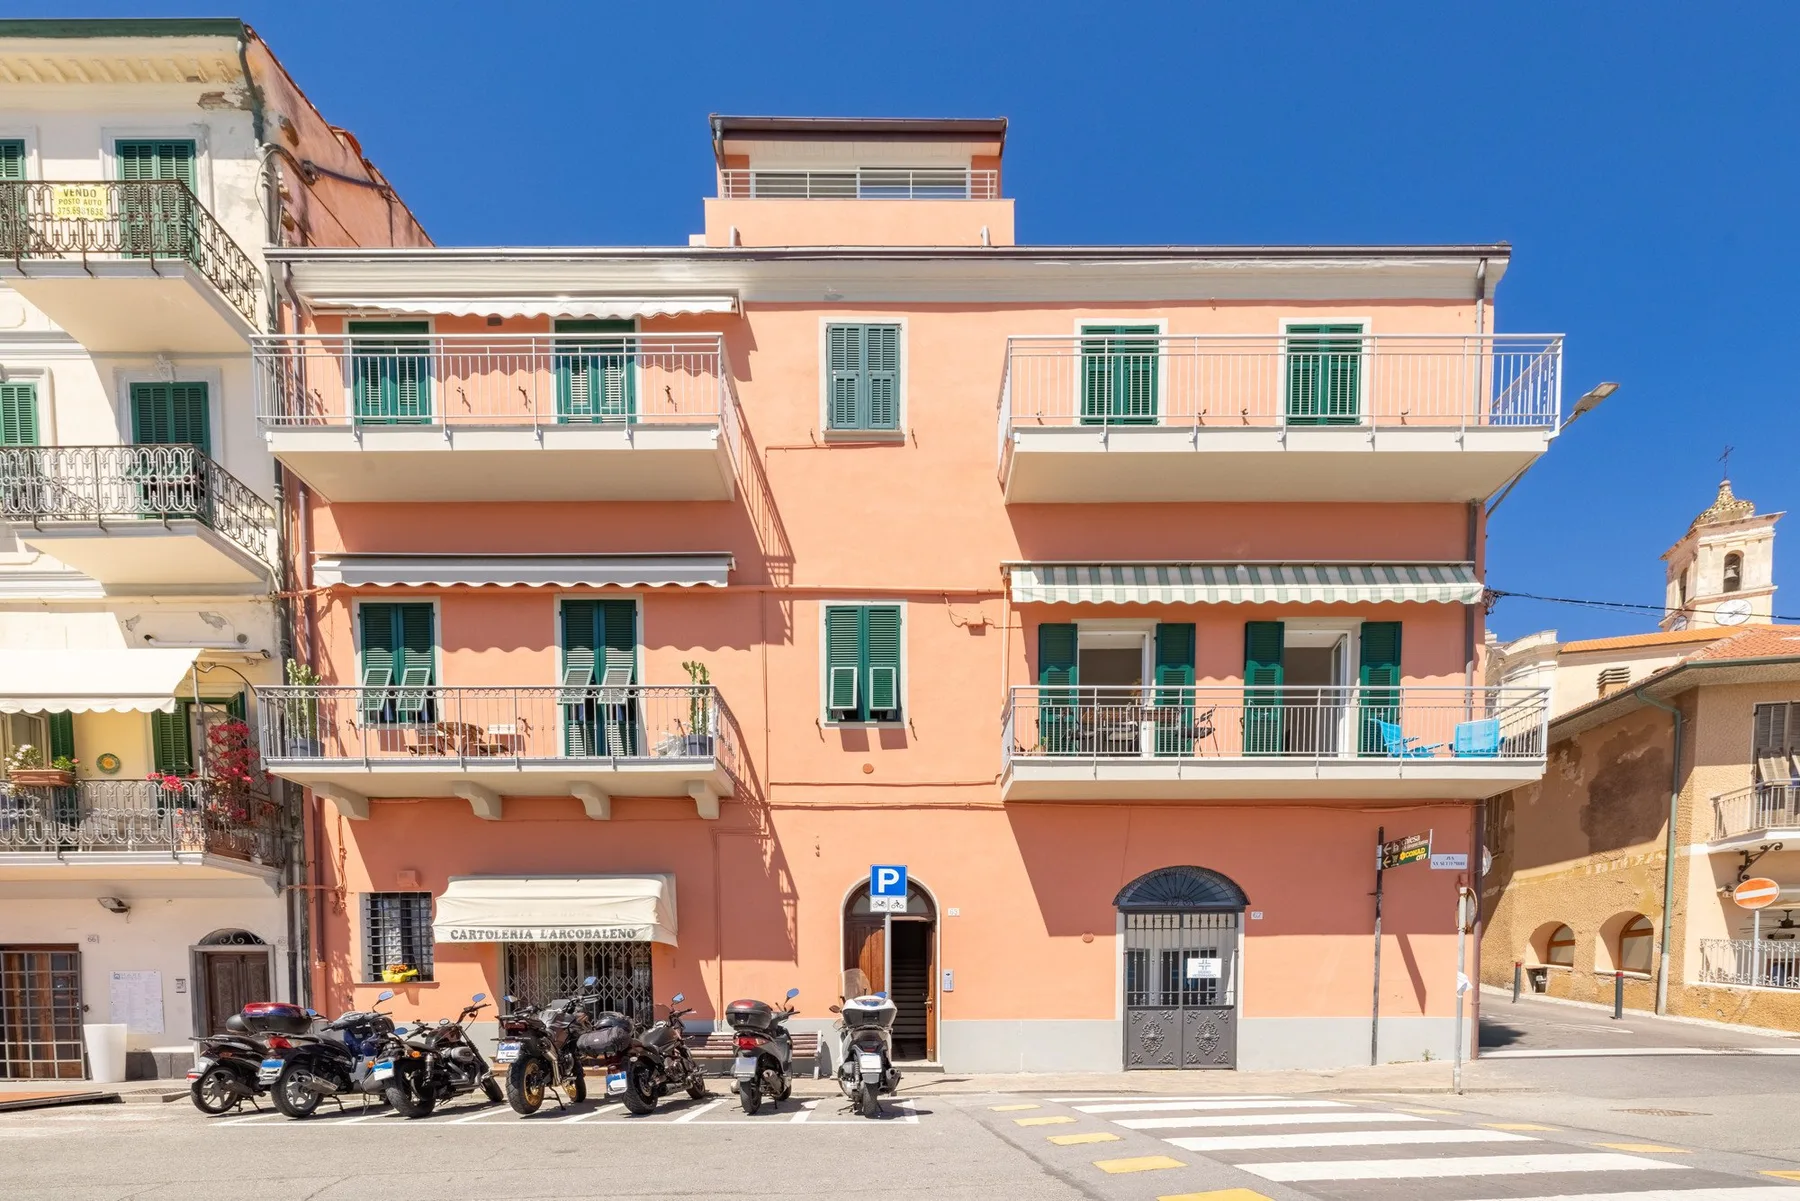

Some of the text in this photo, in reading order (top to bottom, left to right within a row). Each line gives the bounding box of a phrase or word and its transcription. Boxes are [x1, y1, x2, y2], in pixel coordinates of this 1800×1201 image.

[63, 188, 97, 198] VENDO
[58, 198, 80, 206] POSTO
[1405, 847, 1426, 858] CONAD
[878, 868, 900, 894] P
[450, 928, 637, 940] CARTOLERIA L'ARCOBALENO
